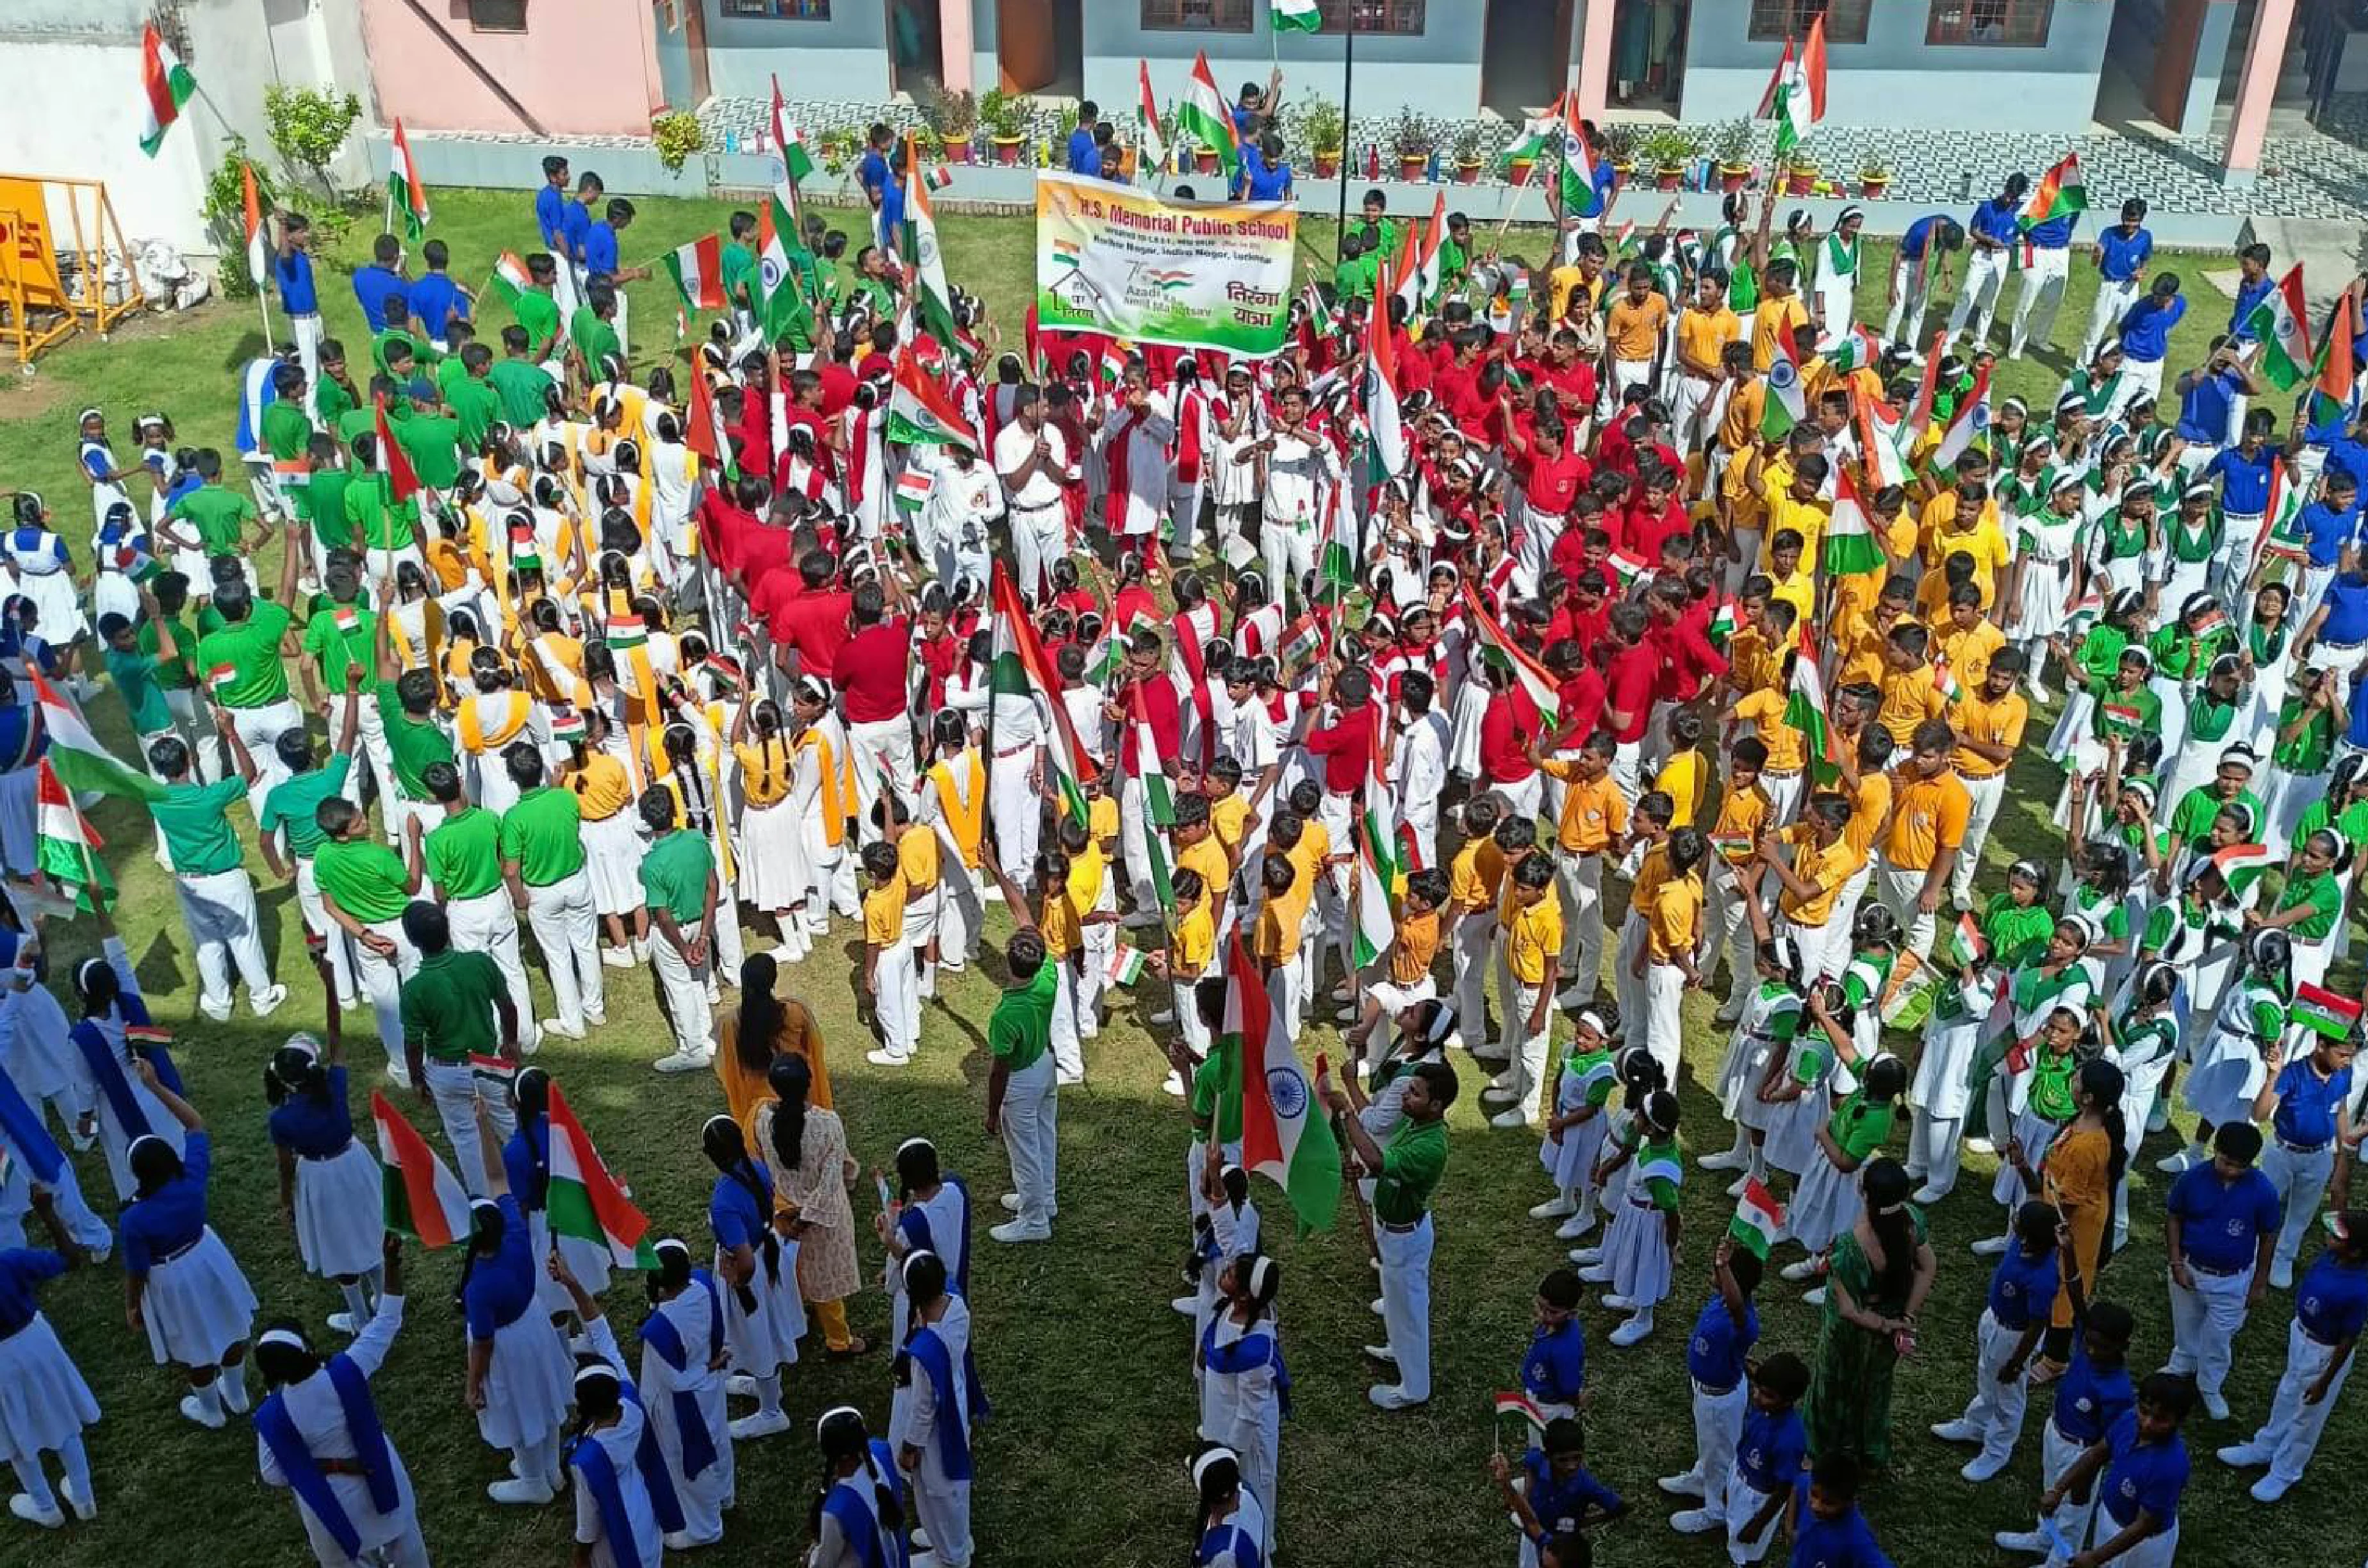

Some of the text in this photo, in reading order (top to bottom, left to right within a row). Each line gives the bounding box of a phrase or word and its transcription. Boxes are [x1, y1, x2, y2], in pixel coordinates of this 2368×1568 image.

[1110, 204, 1176, 233] Memorial
[1182, 216, 1231, 235] Public
[1237, 221, 1289, 240] School
[1225, 281, 1279, 307] तिरंगा
